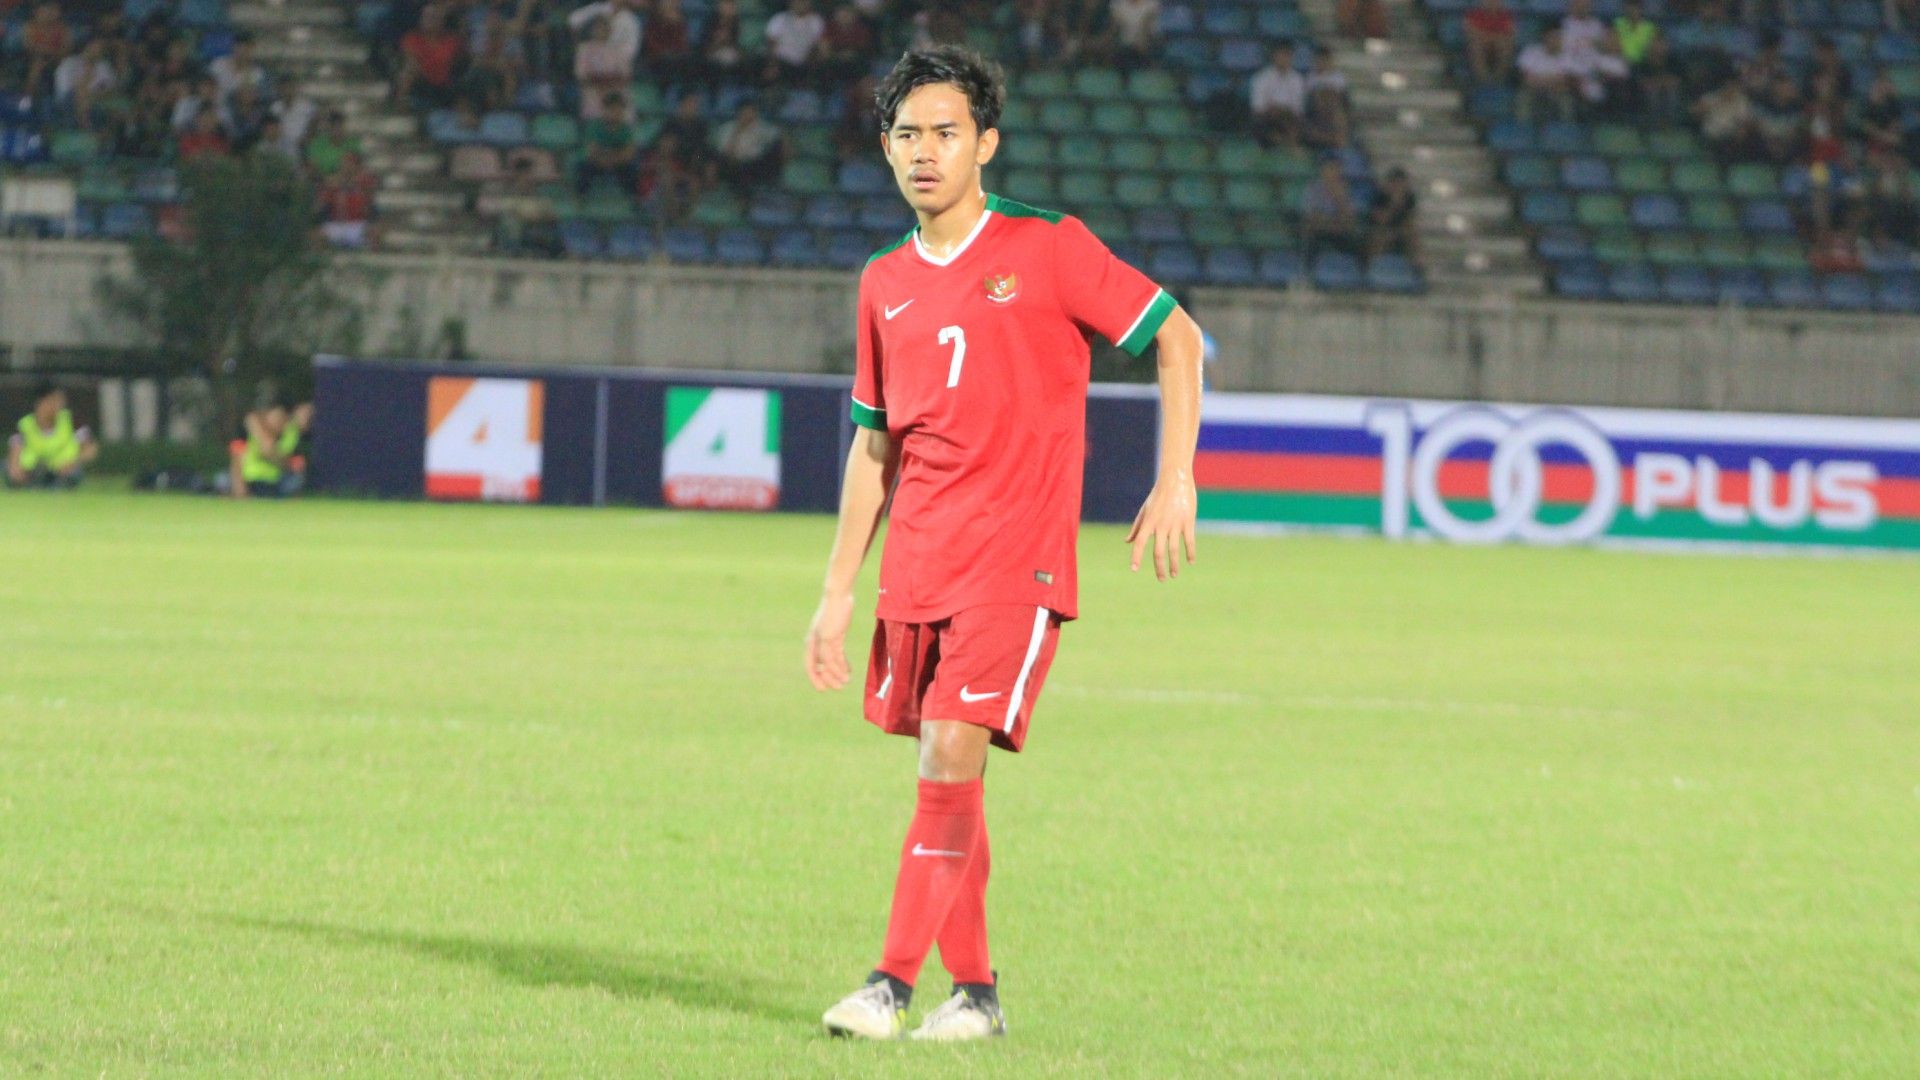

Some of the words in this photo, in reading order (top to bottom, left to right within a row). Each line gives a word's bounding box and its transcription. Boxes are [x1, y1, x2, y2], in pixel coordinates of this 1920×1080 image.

[938, 325, 966, 388] 7
[424, 378, 543, 500] 4
[663, 387, 781, 482] 4
[1366, 399, 1621, 544] 100
[1634, 452, 1878, 531] PLUS
